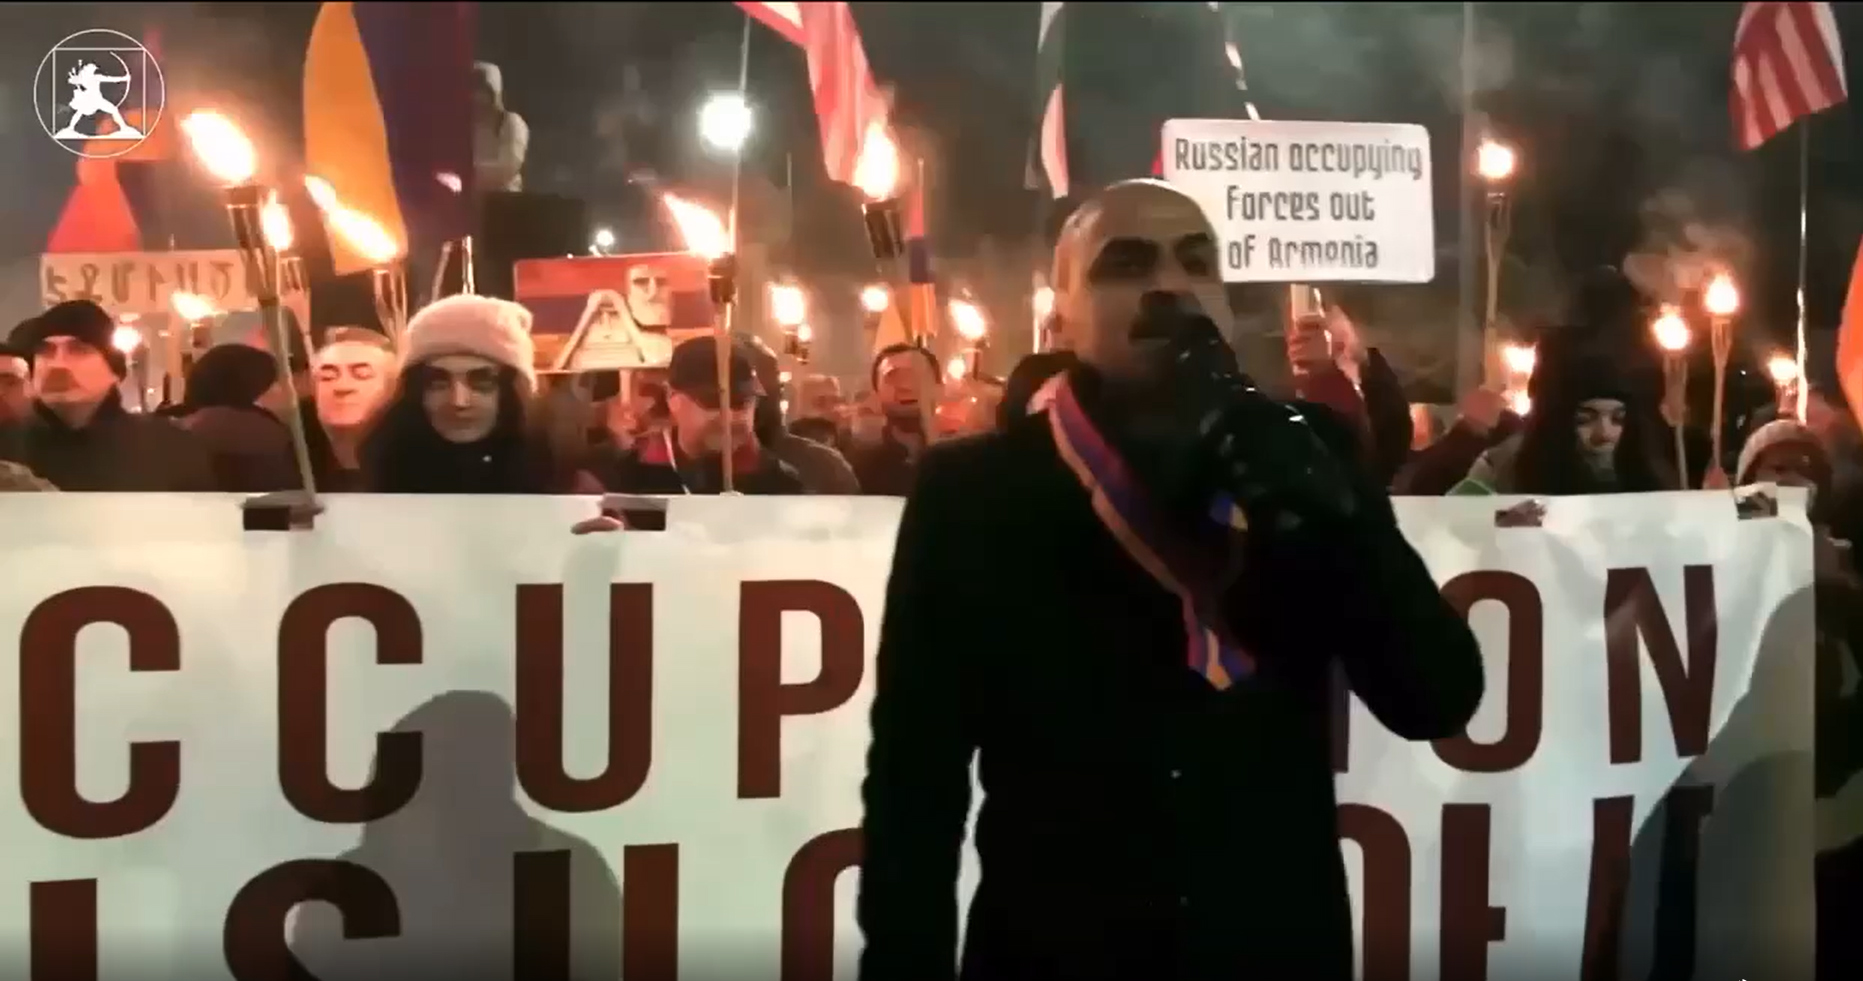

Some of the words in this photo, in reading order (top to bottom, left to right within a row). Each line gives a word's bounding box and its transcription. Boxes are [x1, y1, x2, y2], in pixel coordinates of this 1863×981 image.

[1174, 136, 1279, 171] Russian
[1288, 139, 1423, 181] occupying
[1329, 191, 1375, 221] out
[1228, 234, 1256, 270] of
